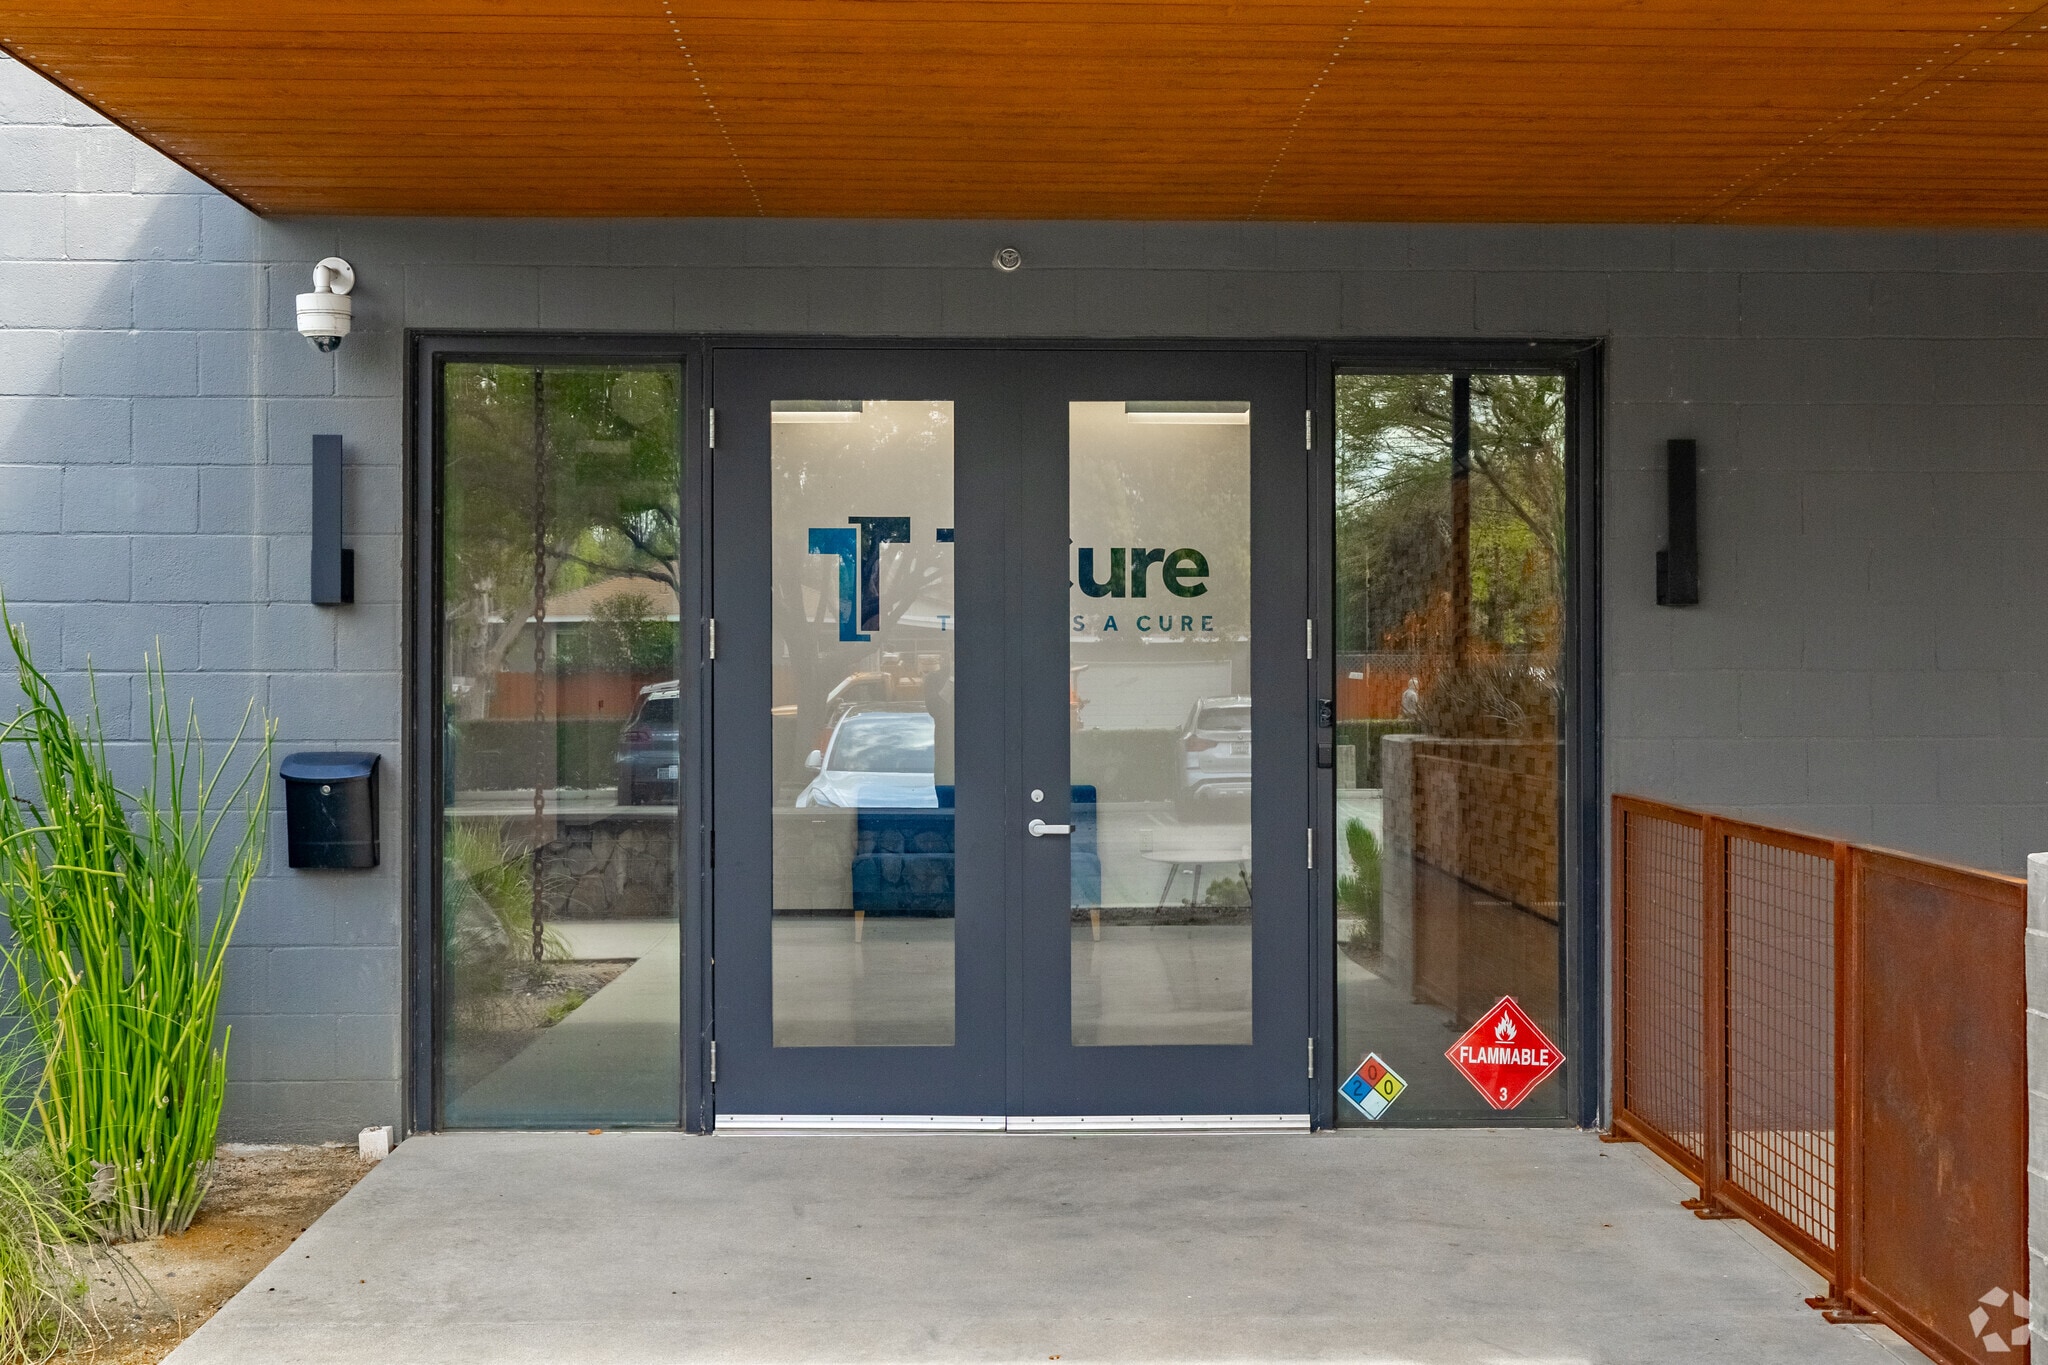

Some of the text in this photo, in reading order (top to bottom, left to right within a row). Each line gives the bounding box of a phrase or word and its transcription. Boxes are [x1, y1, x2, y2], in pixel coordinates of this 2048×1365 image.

[1070, 538, 1210, 598] ure
[1072, 615, 1214, 631] S A CURE
[1459, 1046, 1549, 1066] FLAMMABLE
[1367, 1065, 1378, 1081] 0
[1353, 1079, 1393, 1097] 2 0
[1499, 1087, 1508, 1101] 3
